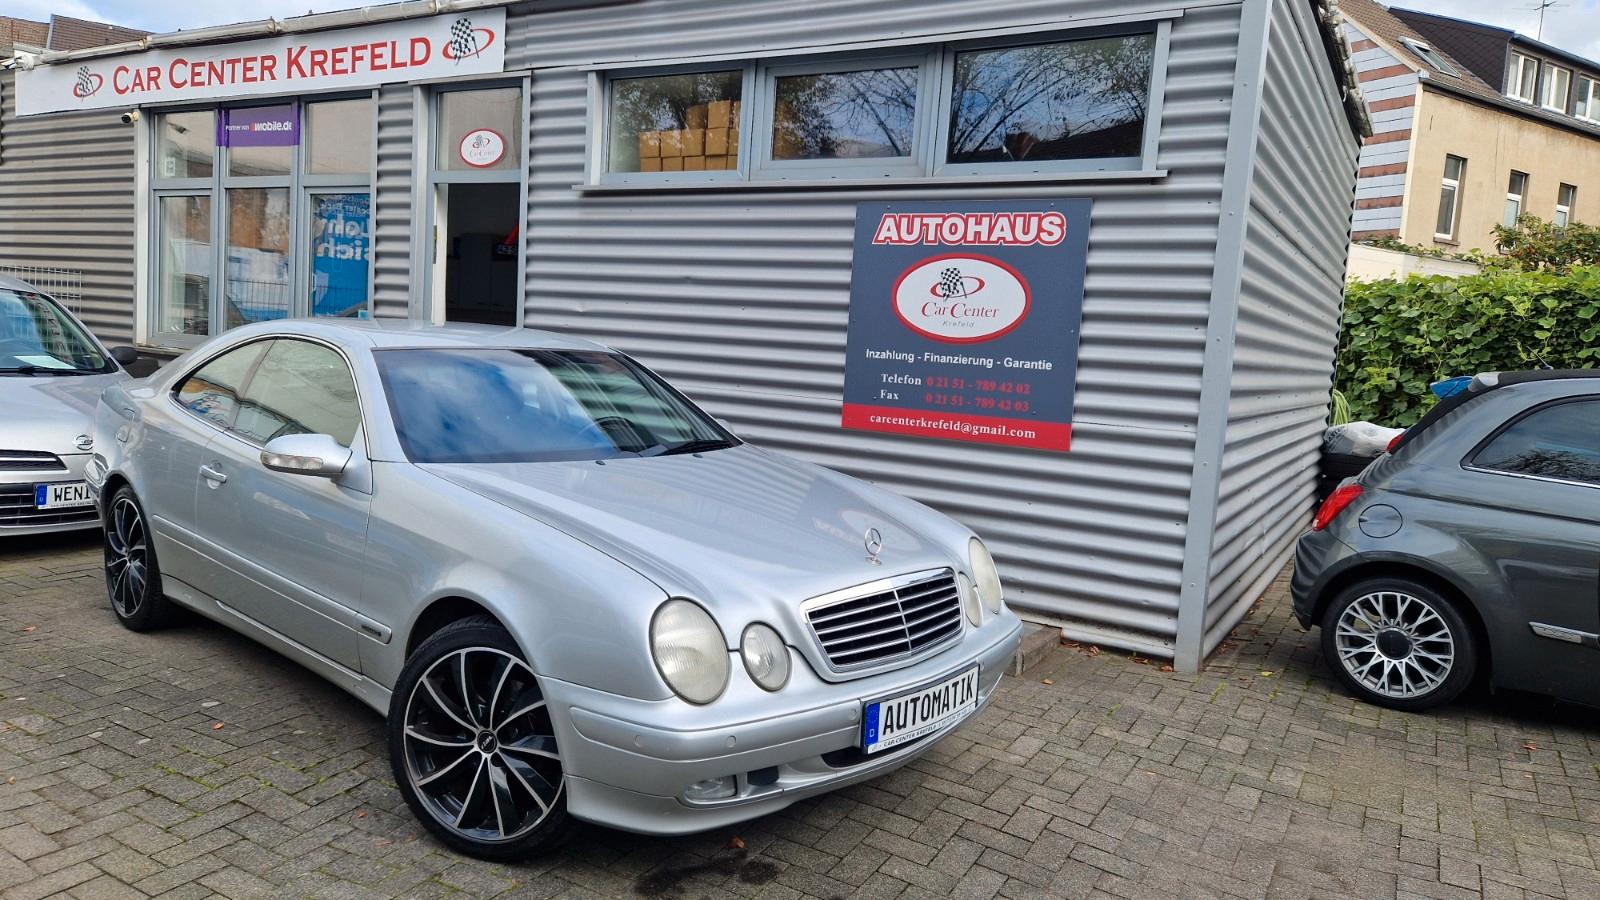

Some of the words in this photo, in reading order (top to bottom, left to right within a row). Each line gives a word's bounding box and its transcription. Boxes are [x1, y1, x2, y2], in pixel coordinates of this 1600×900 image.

[113, 65, 162, 95] CAR
[168, 58, 278, 89] CENTER
[286, 37, 431, 80] KREFELD
[872, 212, 1066, 246] AUTOHAUS
[921, 301, 948, 317] Car
[950, 303, 1000, 319] Center
[942, 320, 975, 328] Krefeld
[865, 349, 914, 362] Inzahlung
[923, 352, 993, 368] Finanzierung
[1003, 357, 1053, 370] Garantie
[880, 373, 922, 385] Telefon
[880, 389, 899, 400] Fax
[870, 414, 1036, 439] carcenterkrefeld@gmail.com
[883, 672, 975, 736] AUTOMATIK
